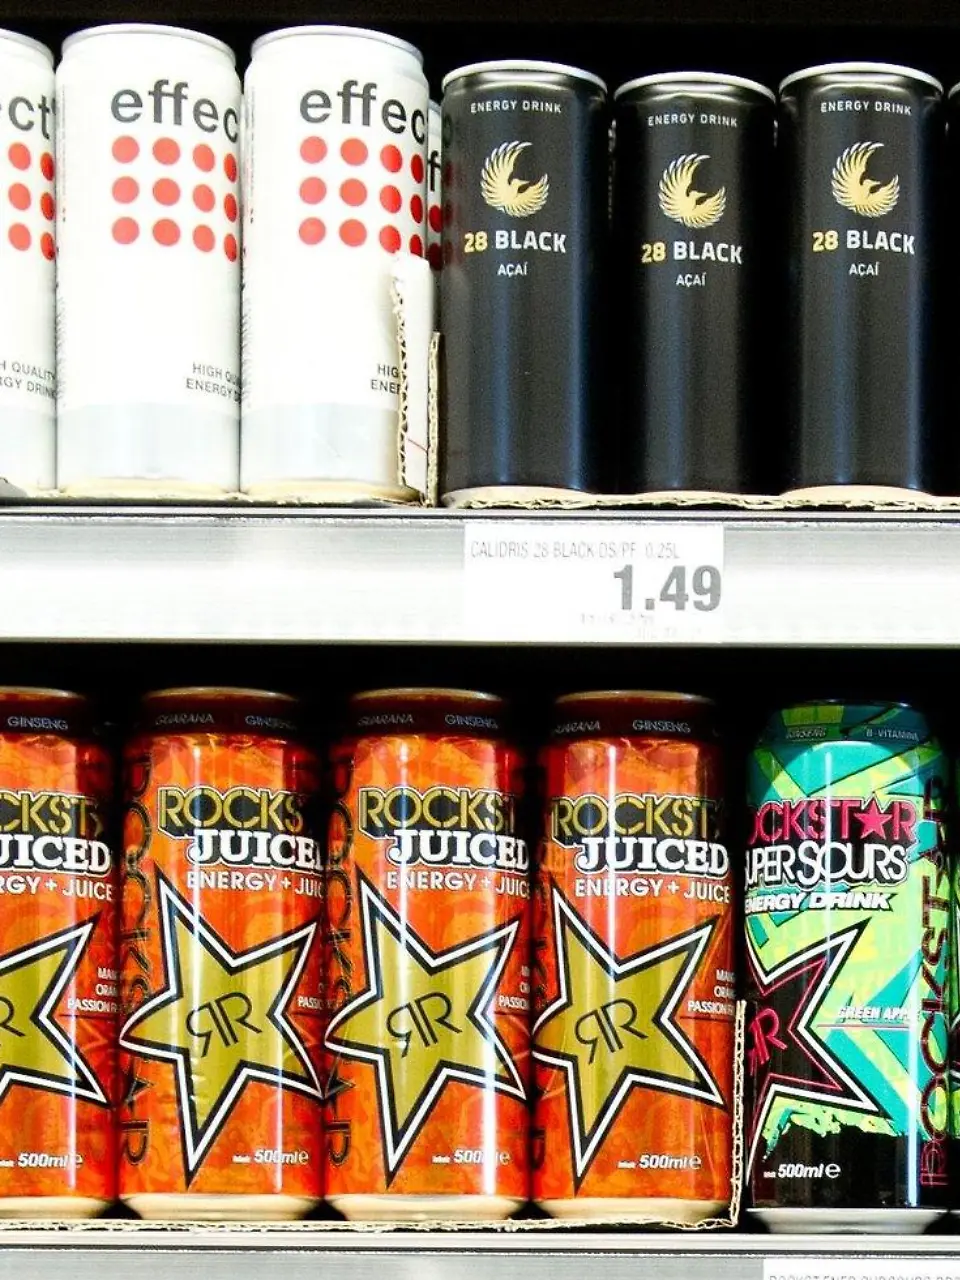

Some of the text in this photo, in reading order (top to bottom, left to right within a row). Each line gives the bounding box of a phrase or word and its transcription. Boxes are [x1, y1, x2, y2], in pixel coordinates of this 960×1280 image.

[470, 99, 562, 114] ENERGY DRINK
[820, 100, 912, 116] ENERGY DRINK
[648, 113, 738, 128] ENERGY DRINK
[463, 230, 566, 254] 28 BLACK
[812, 229, 915, 255] 28 BLACK
[641, 240, 743, 265] 28 BLACK
[497, 261, 527, 277] AÇAÍ
[849, 261, 879, 277] AÇAÍ
[676, 271, 706, 287] AÇAÍ
[192, 362, 223, 378] HIGH
[553, 541, 594, 558] BLACK
[613, 564, 721, 611] 1.49
[8, 716, 68, 731] GINSENG
[632, 719, 691, 733] GINSENG
[388, 829, 530, 874] JUICED
[575, 838, 730, 878] JUICED
[187, 871, 276, 892] ENERGY
[386, 870, 476, 891] ENERGY
[574, 878, 731, 903] ENERGY JUICE
[806, 890, 892, 910] DRINK
[838, 1006, 880, 1021] GREEN
